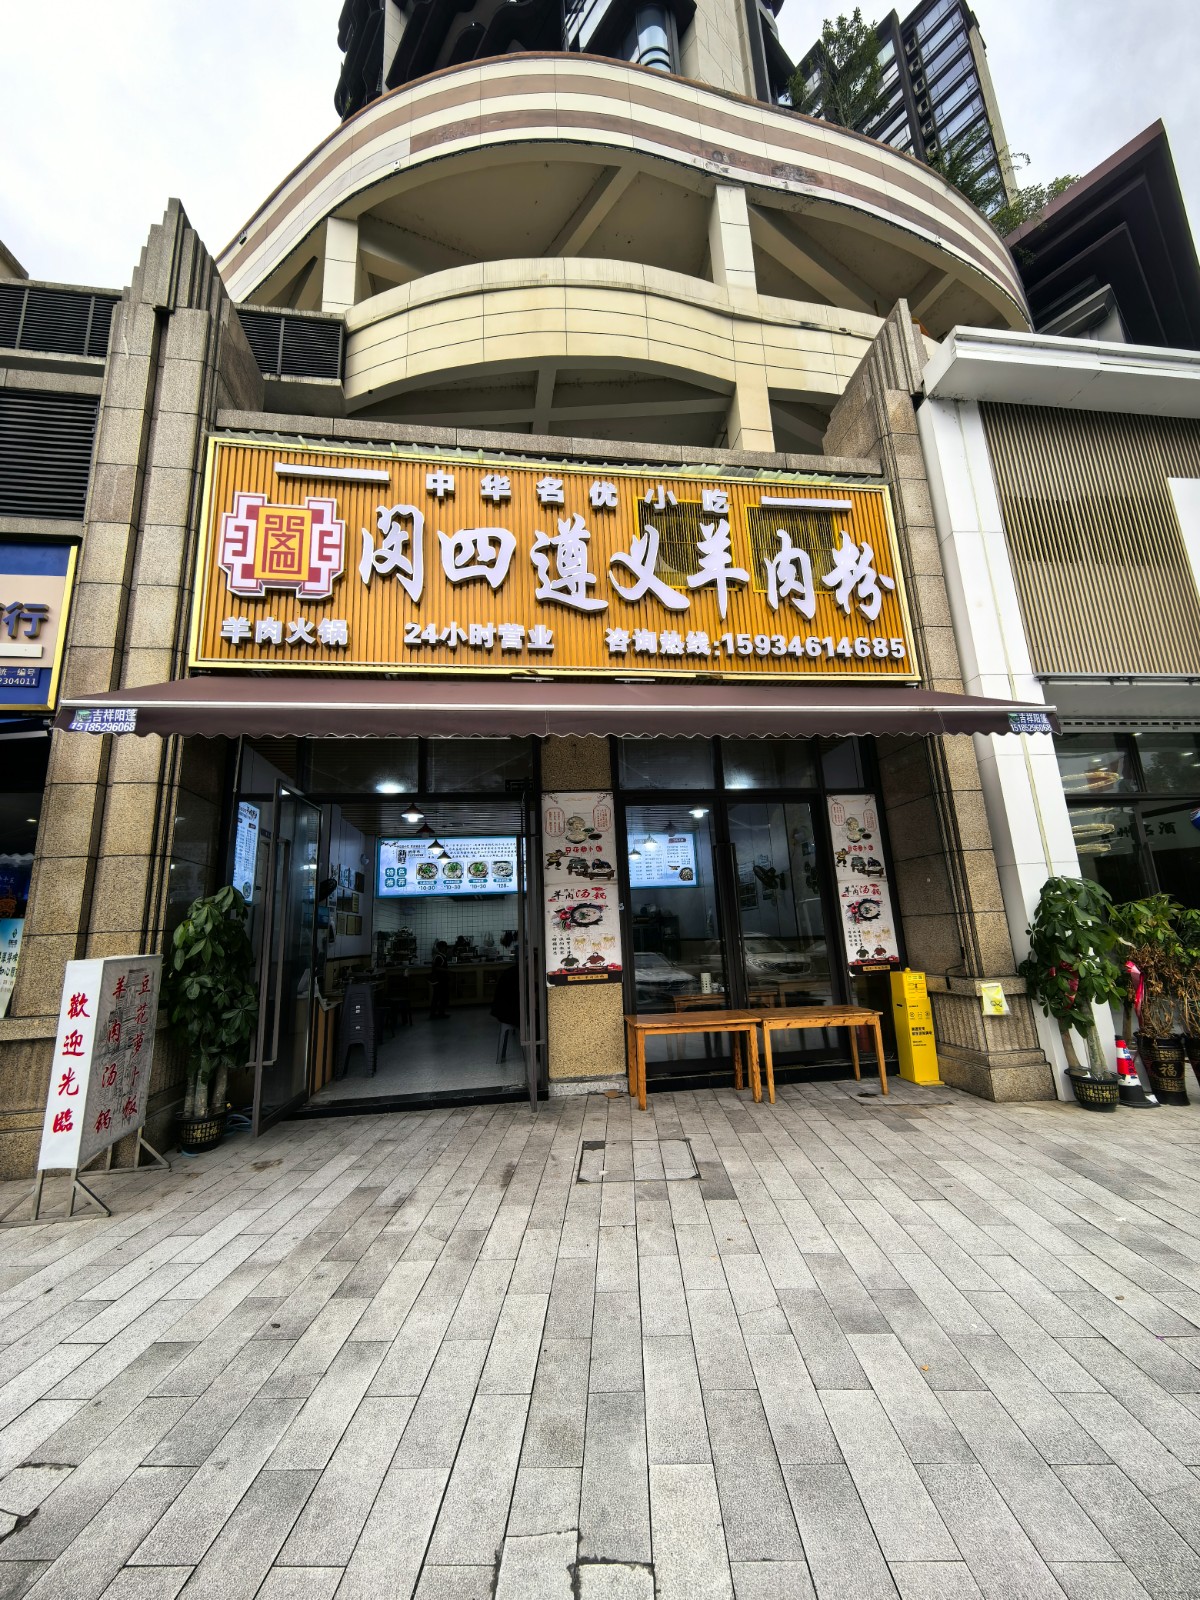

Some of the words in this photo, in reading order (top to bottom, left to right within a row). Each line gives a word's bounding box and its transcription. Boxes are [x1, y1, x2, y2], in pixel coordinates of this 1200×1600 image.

[426, 470, 730, 515] 中华名优小吃
[359, 504, 895, 622] 闵四遵义羊肉粉
[0, 601, 50, 639] 行
[220, 616, 349, 646] 羊肉火锅
[404, 621, 554, 651] 24小时营业
[605, 627, 906, 659] 咨询热线:15934614685
[71, 722, 136, 732] 15185296068
[92, 708, 138, 722] 吉祥阳篷
[52, 992, 91, 1133] 歡迎光臨
[93, 975, 127, 1135] 羊肉汤锅
[1158, 1063, 1177, 1077] 福
